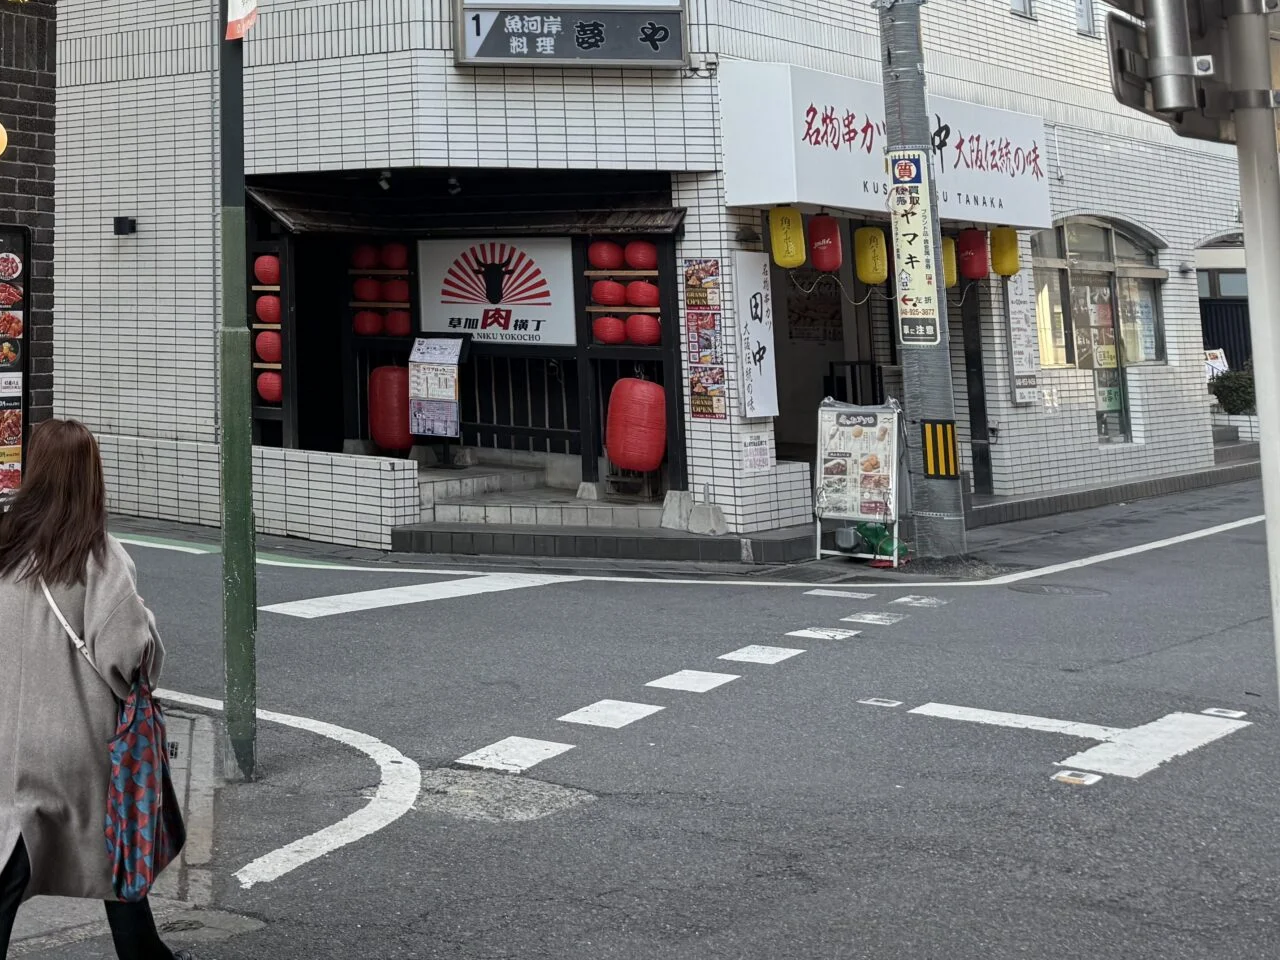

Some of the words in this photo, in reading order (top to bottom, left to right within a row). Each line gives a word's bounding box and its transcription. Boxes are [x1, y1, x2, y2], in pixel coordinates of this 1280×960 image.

[471, 14, 481, 37] 1
[504, 15, 563, 34] 魚河岸
[509, 36, 555, 55] 料理
[953, 130, 1044, 181] 大阪伝統の味
[897, 162, 913, 180] 質
[958, 192, 1004, 209] TANAKA
[901, 209, 921, 270] ヤマキ
[448, 307, 546, 331] 草加肉横丁
[477, 332, 498, 340] NIKU
[500, 332, 541, 341] YOKOCHO
[750, 291, 767, 376] 田中
